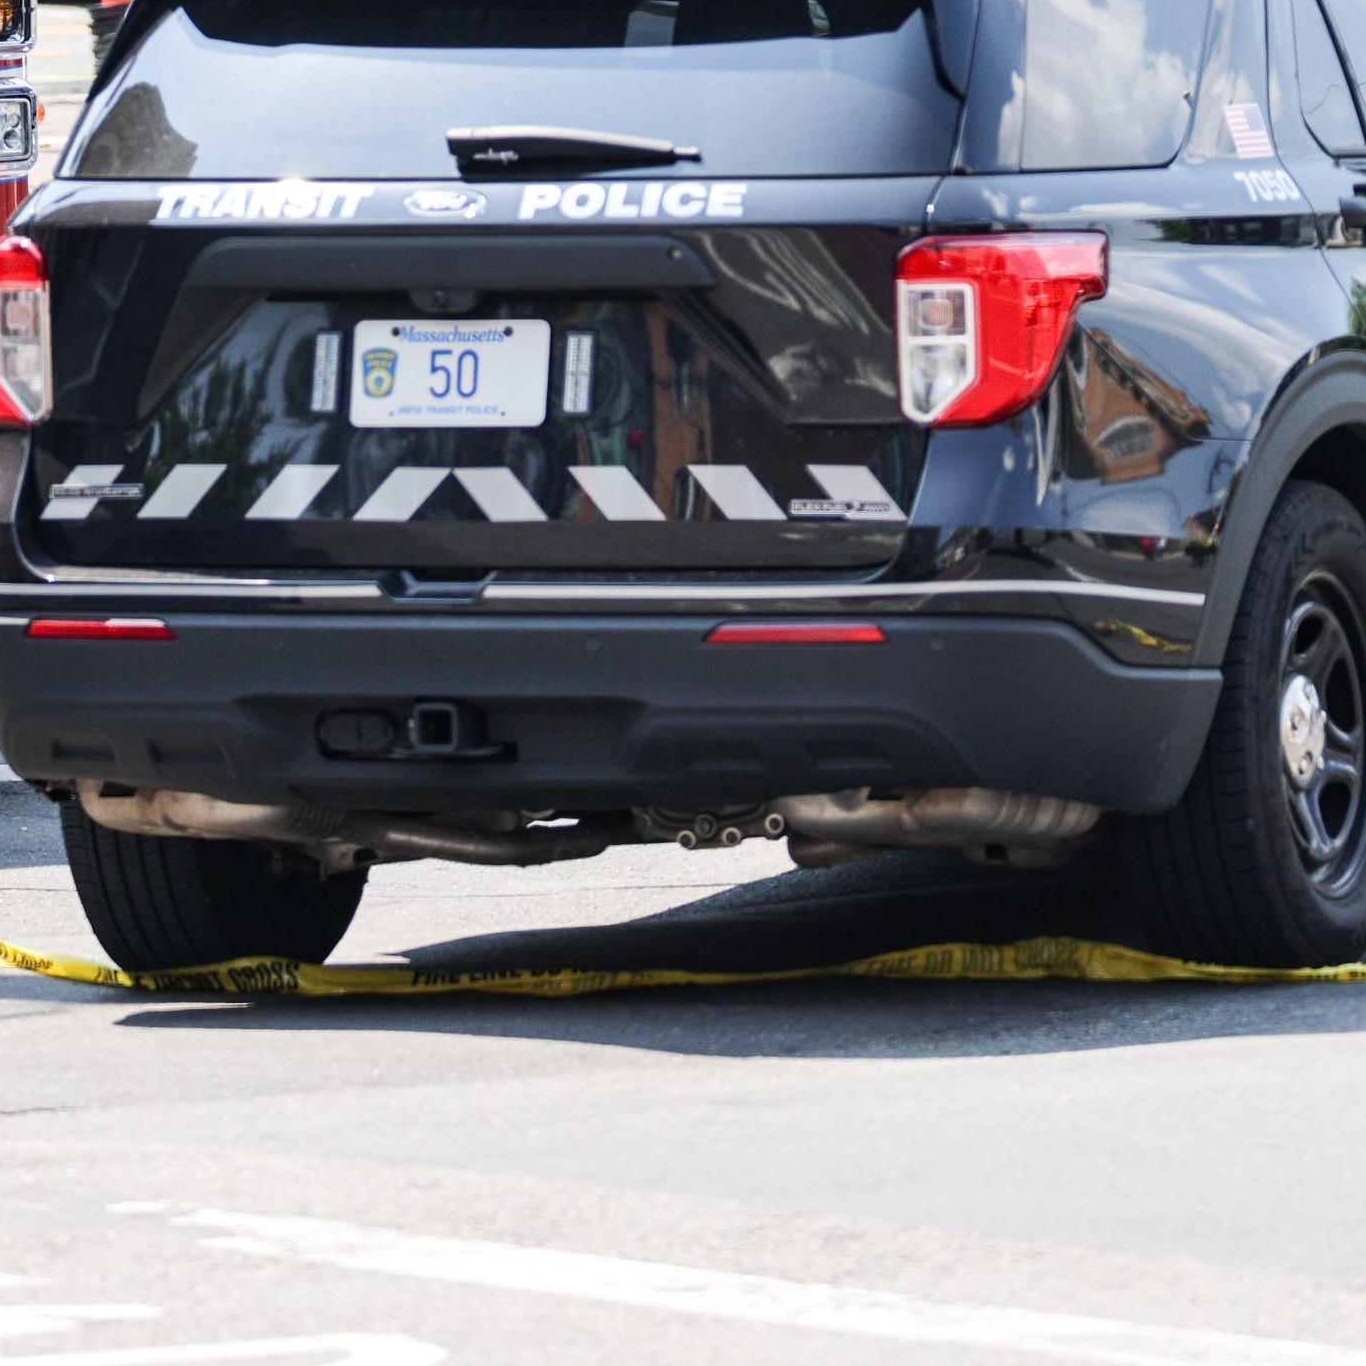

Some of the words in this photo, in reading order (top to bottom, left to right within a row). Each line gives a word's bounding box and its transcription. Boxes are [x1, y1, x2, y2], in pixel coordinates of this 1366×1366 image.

[155, 184, 375, 220] TRANSIT
[518, 182, 749, 220] POLICE
[1233, 170, 1301, 203] 7050
[398, 325, 506, 343] Massachusetts
[429, 349, 479, 398] 50
[426, 406, 463, 415] TRANSIT
[465, 405, 499, 415] POLICE
